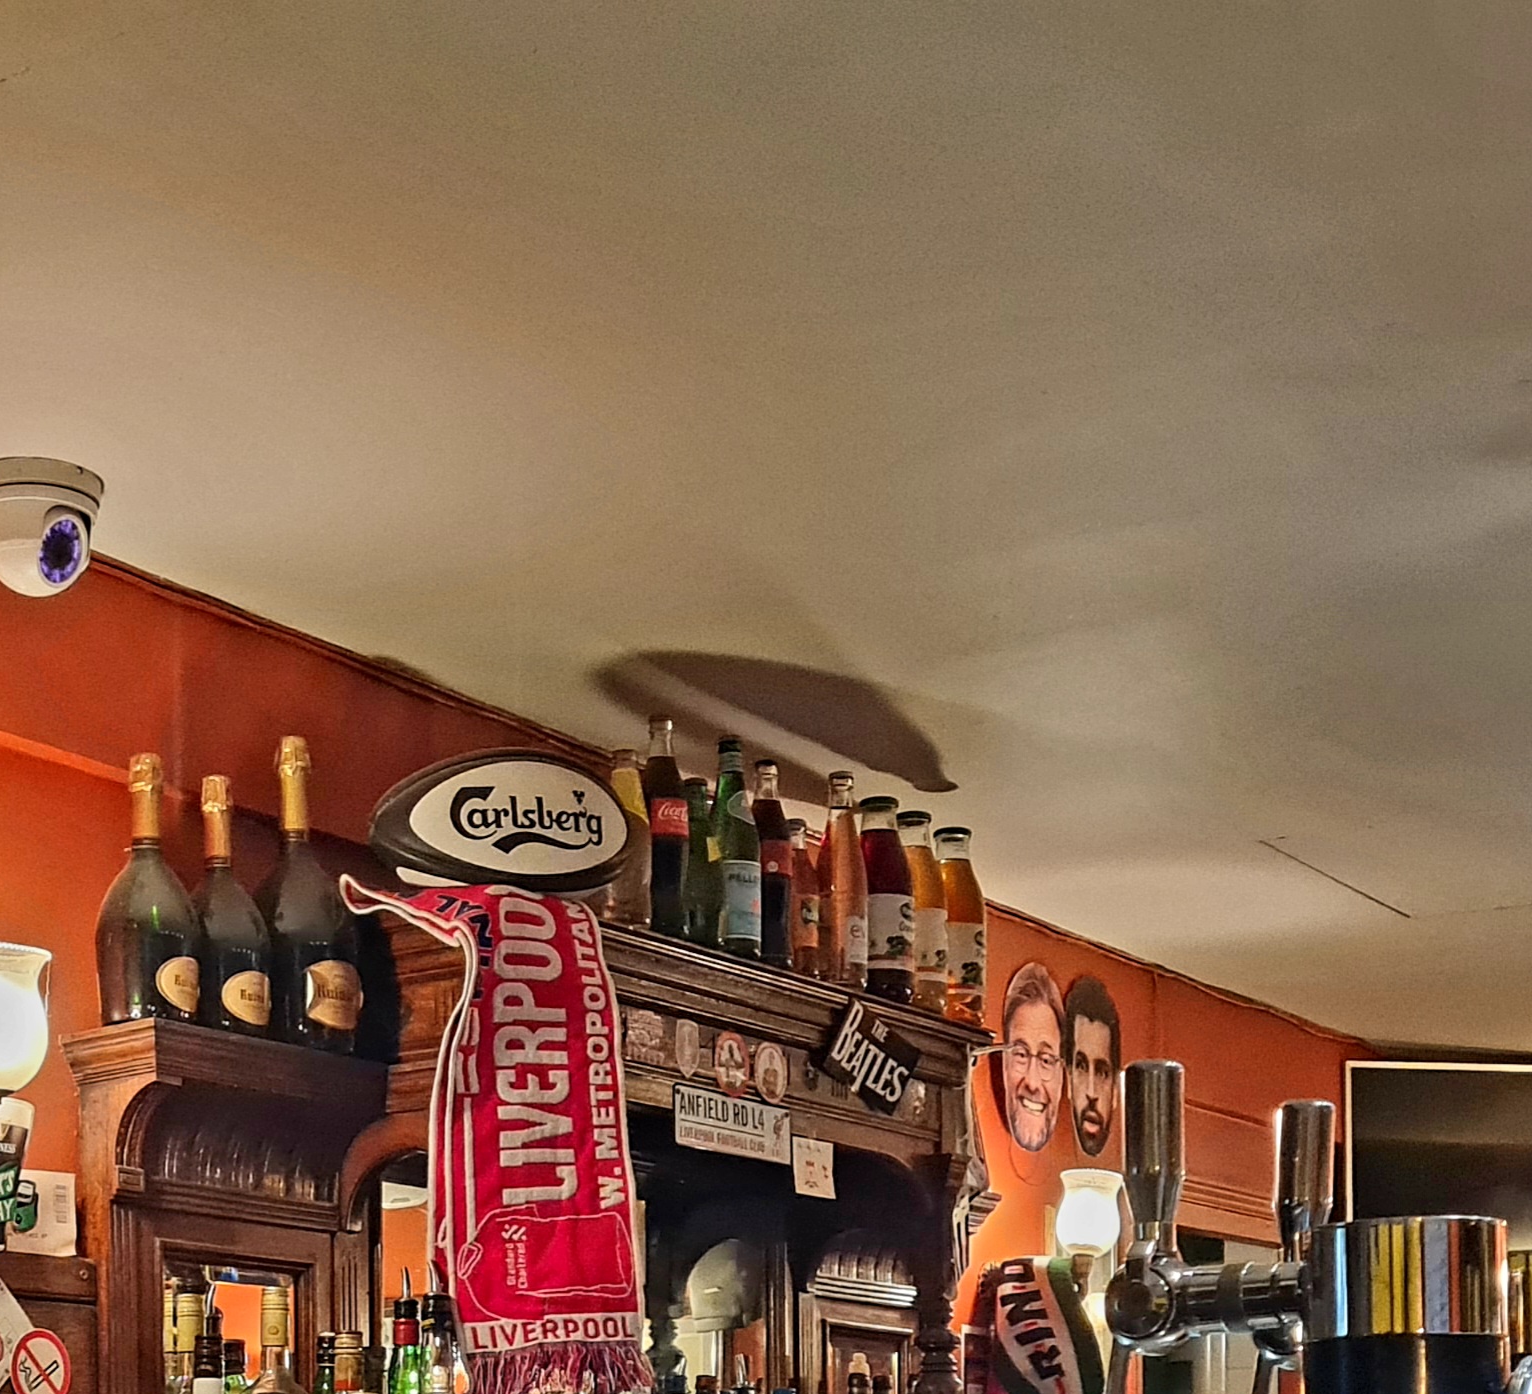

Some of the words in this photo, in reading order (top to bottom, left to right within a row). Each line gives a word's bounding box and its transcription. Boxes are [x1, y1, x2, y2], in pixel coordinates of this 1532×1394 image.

[450, 786, 602, 854] Carlsberg
[492, 886, 579, 1206] LIVERPOO
[831, 1000, 909, 1103] BEATLES
[870, 1018, 889, 1043] THE
[679, 1091, 729, 1123] ANFIELD
[733, 1103, 749, 1128] RD
[752, 1107, 765, 1132] L4
[600, 1166, 625, 1210] W.
[471, 1315, 635, 1350] LIVERPOOL
